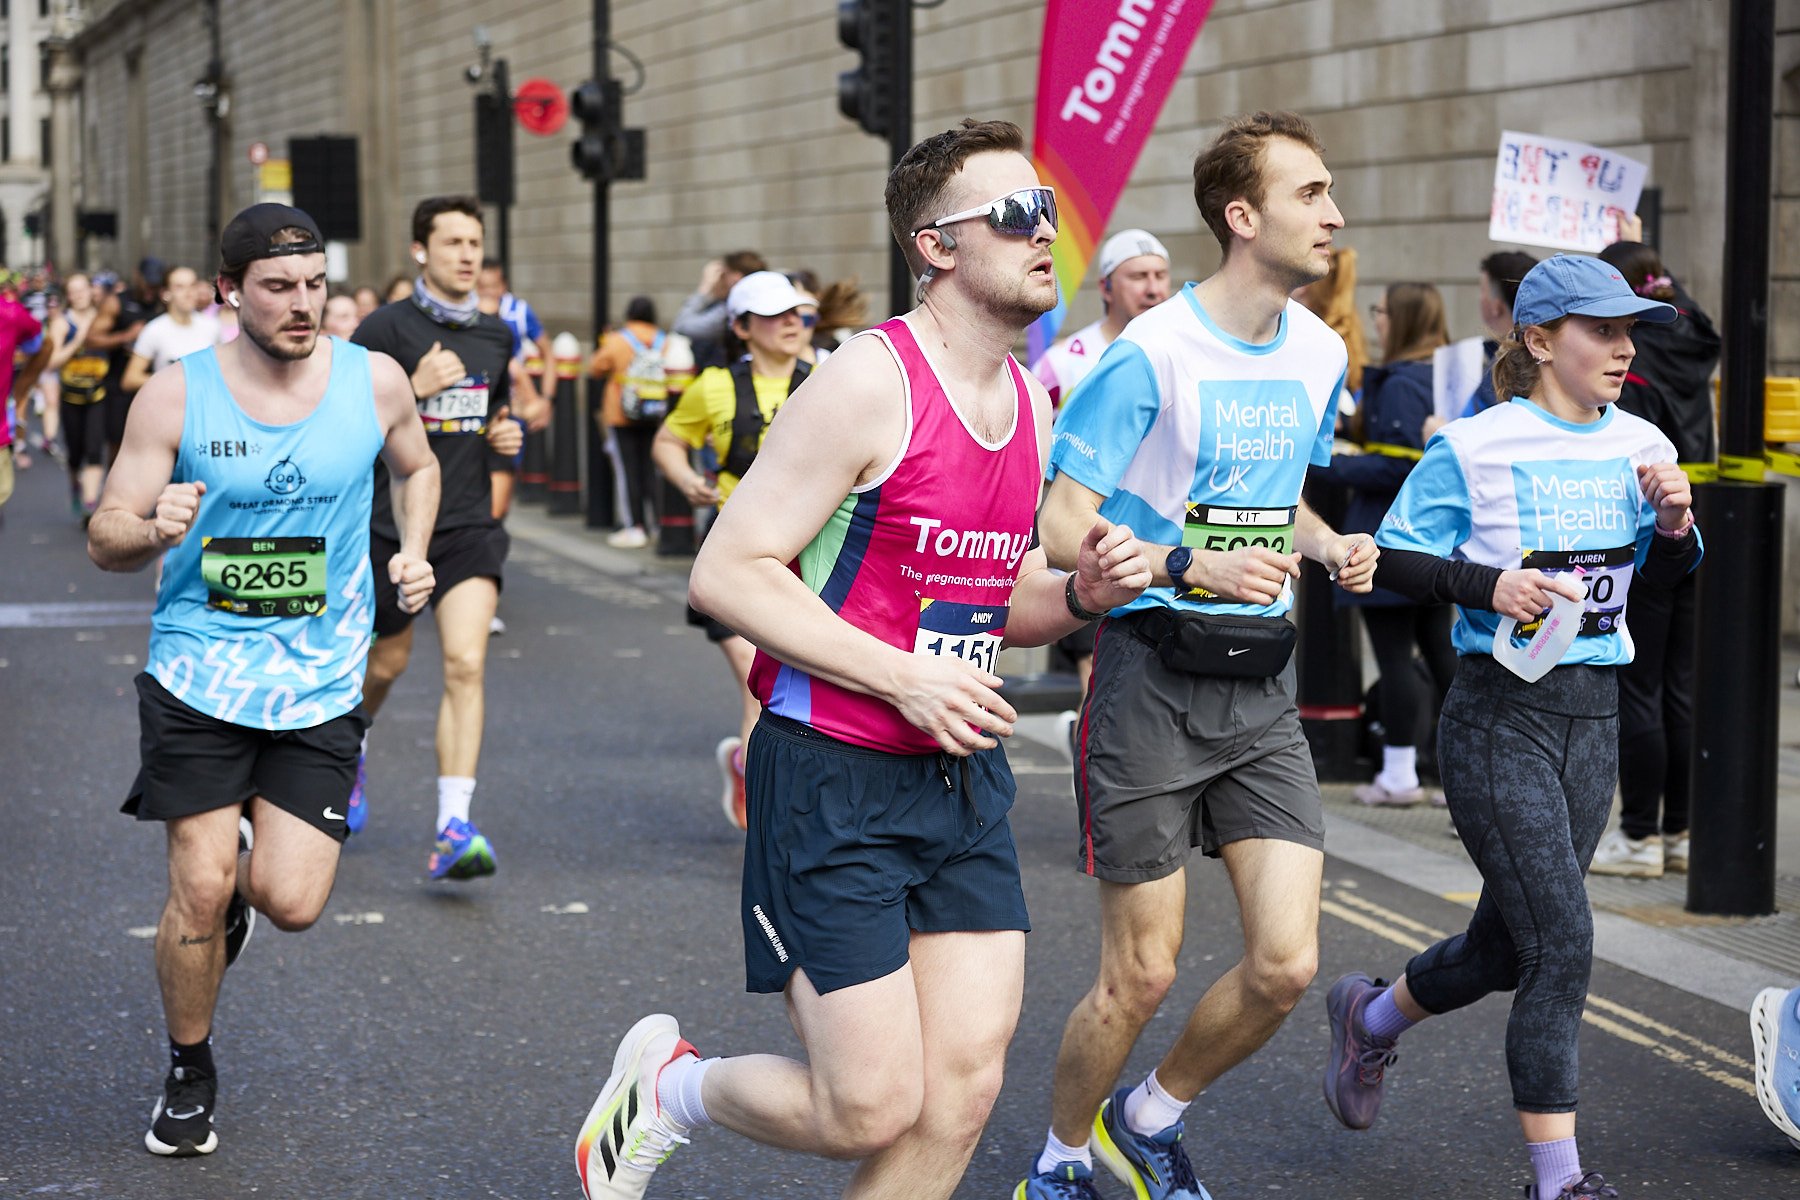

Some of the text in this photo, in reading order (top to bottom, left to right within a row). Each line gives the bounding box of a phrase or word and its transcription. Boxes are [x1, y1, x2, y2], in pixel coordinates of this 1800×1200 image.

[1214, 396, 1301, 429] Mental
[211, 441, 247, 458] BEN
[1214, 429, 1295, 461] Health
[1208, 464, 1252, 493] UK
[1530, 472, 1628, 502] Mental
[228, 495, 338, 510] GREAT ORMOND STREET
[1235, 511, 1261, 523] KIT
[1534, 500, 1627, 532] Health
[252, 542, 276, 552] BEN
[1568, 553, 1606, 564] LAUREN
[221, 560, 308, 591] 6265
[900, 565, 923, 581] The
[970, 611, 993, 624] ANDY
